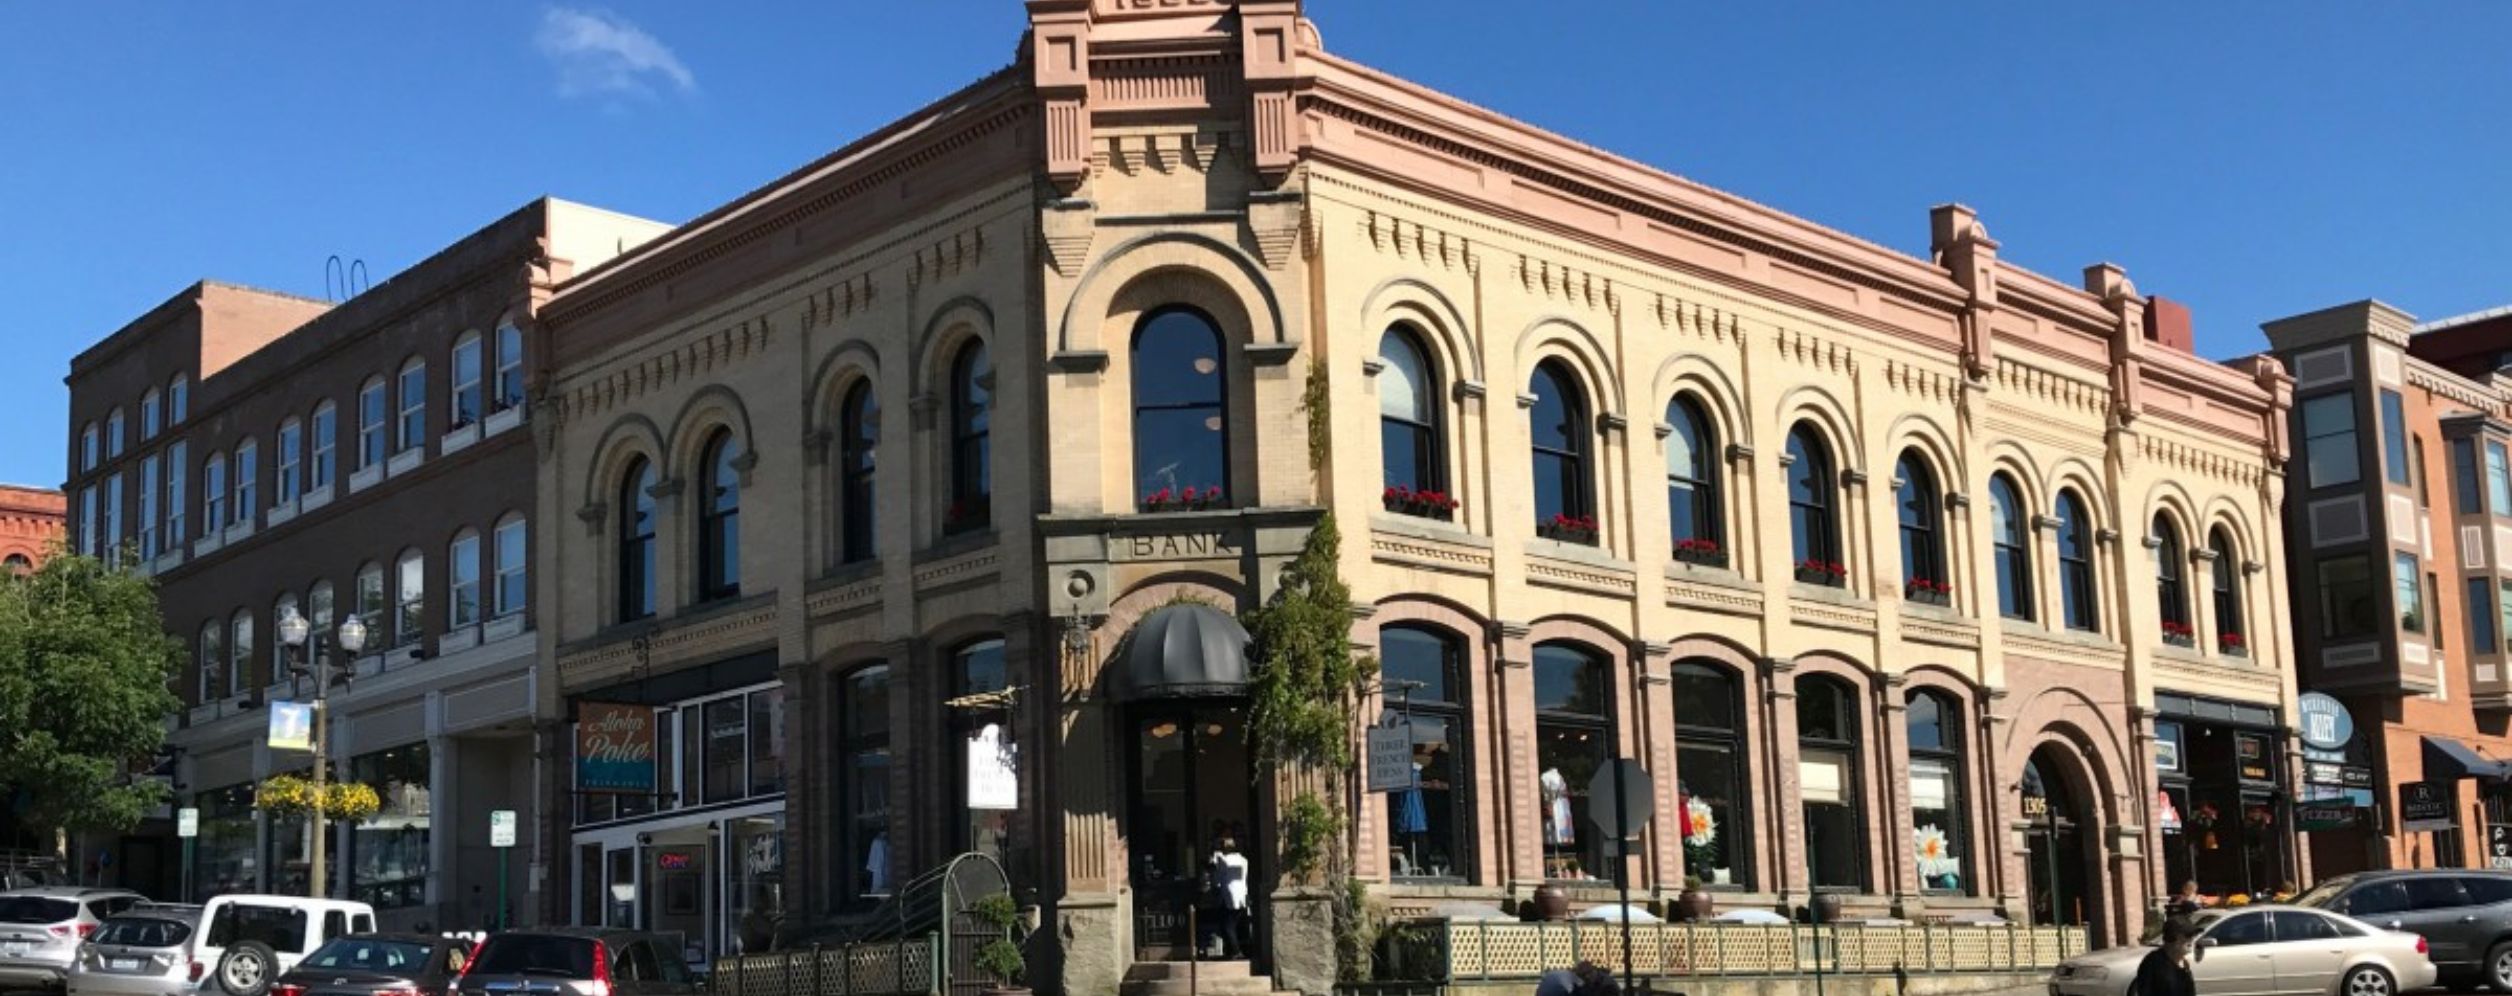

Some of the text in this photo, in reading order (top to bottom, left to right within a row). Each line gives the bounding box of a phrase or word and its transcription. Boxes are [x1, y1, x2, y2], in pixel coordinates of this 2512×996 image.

[1133, 531, 1232, 556] BANK
[588, 709, 646, 732] Aloha
[585, 731, 651, 763] Poke
[2023, 796, 2048, 814] 1305
